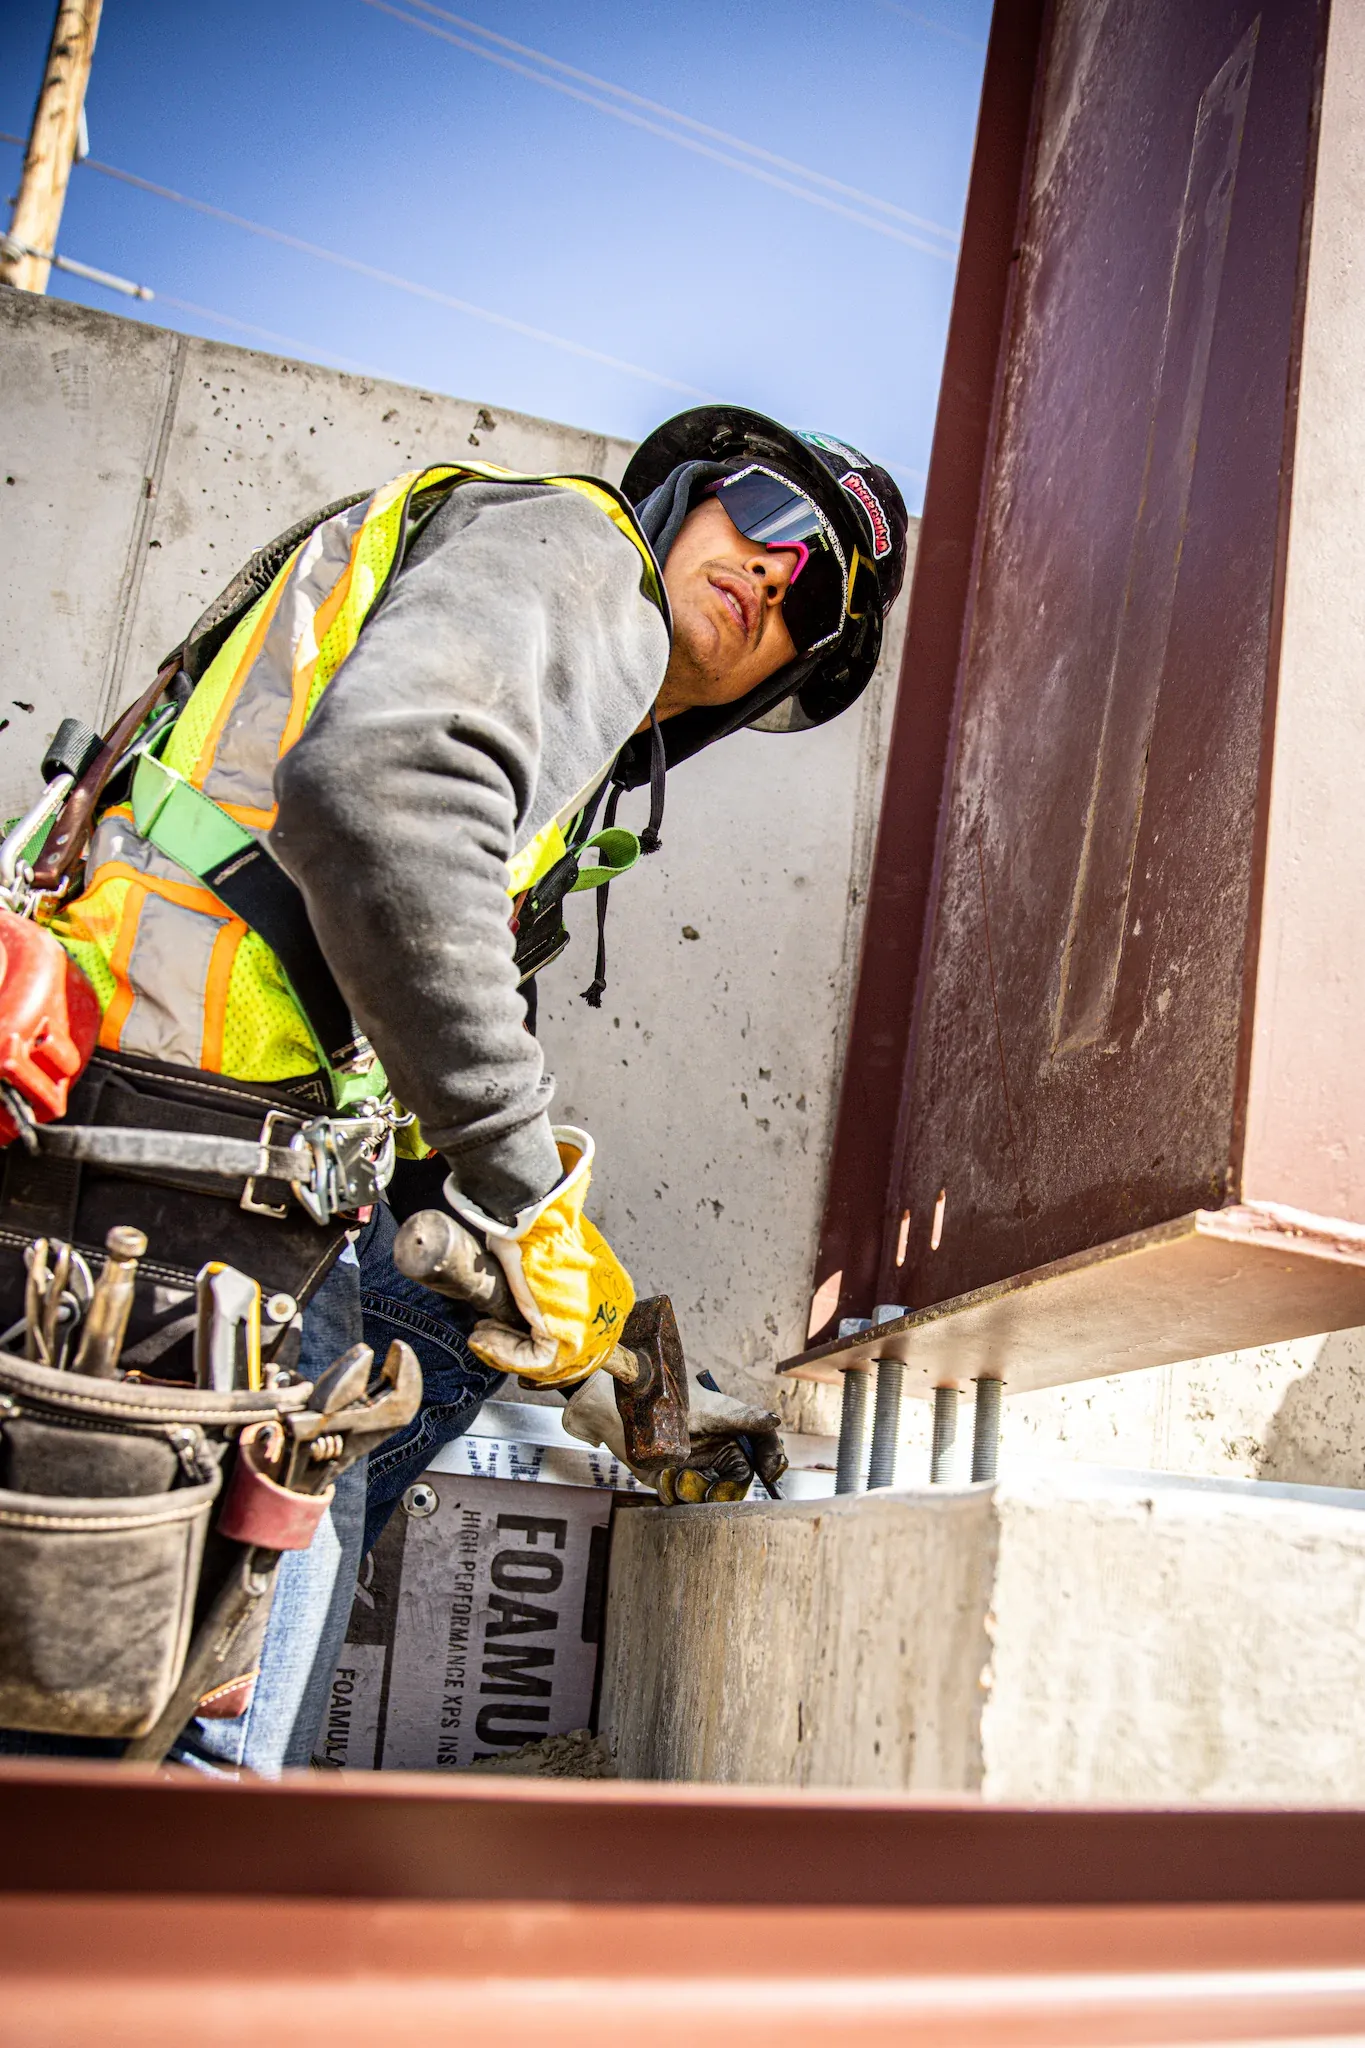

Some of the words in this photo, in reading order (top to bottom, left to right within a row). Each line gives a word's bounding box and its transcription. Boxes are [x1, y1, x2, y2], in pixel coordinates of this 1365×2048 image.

[460, 1509, 481, 1557] HIGH
[444, 1561, 476, 1689] PERFORMANCE
[472, 1513, 568, 1762] FOAMU
[440, 1694, 463, 1729] XPS
